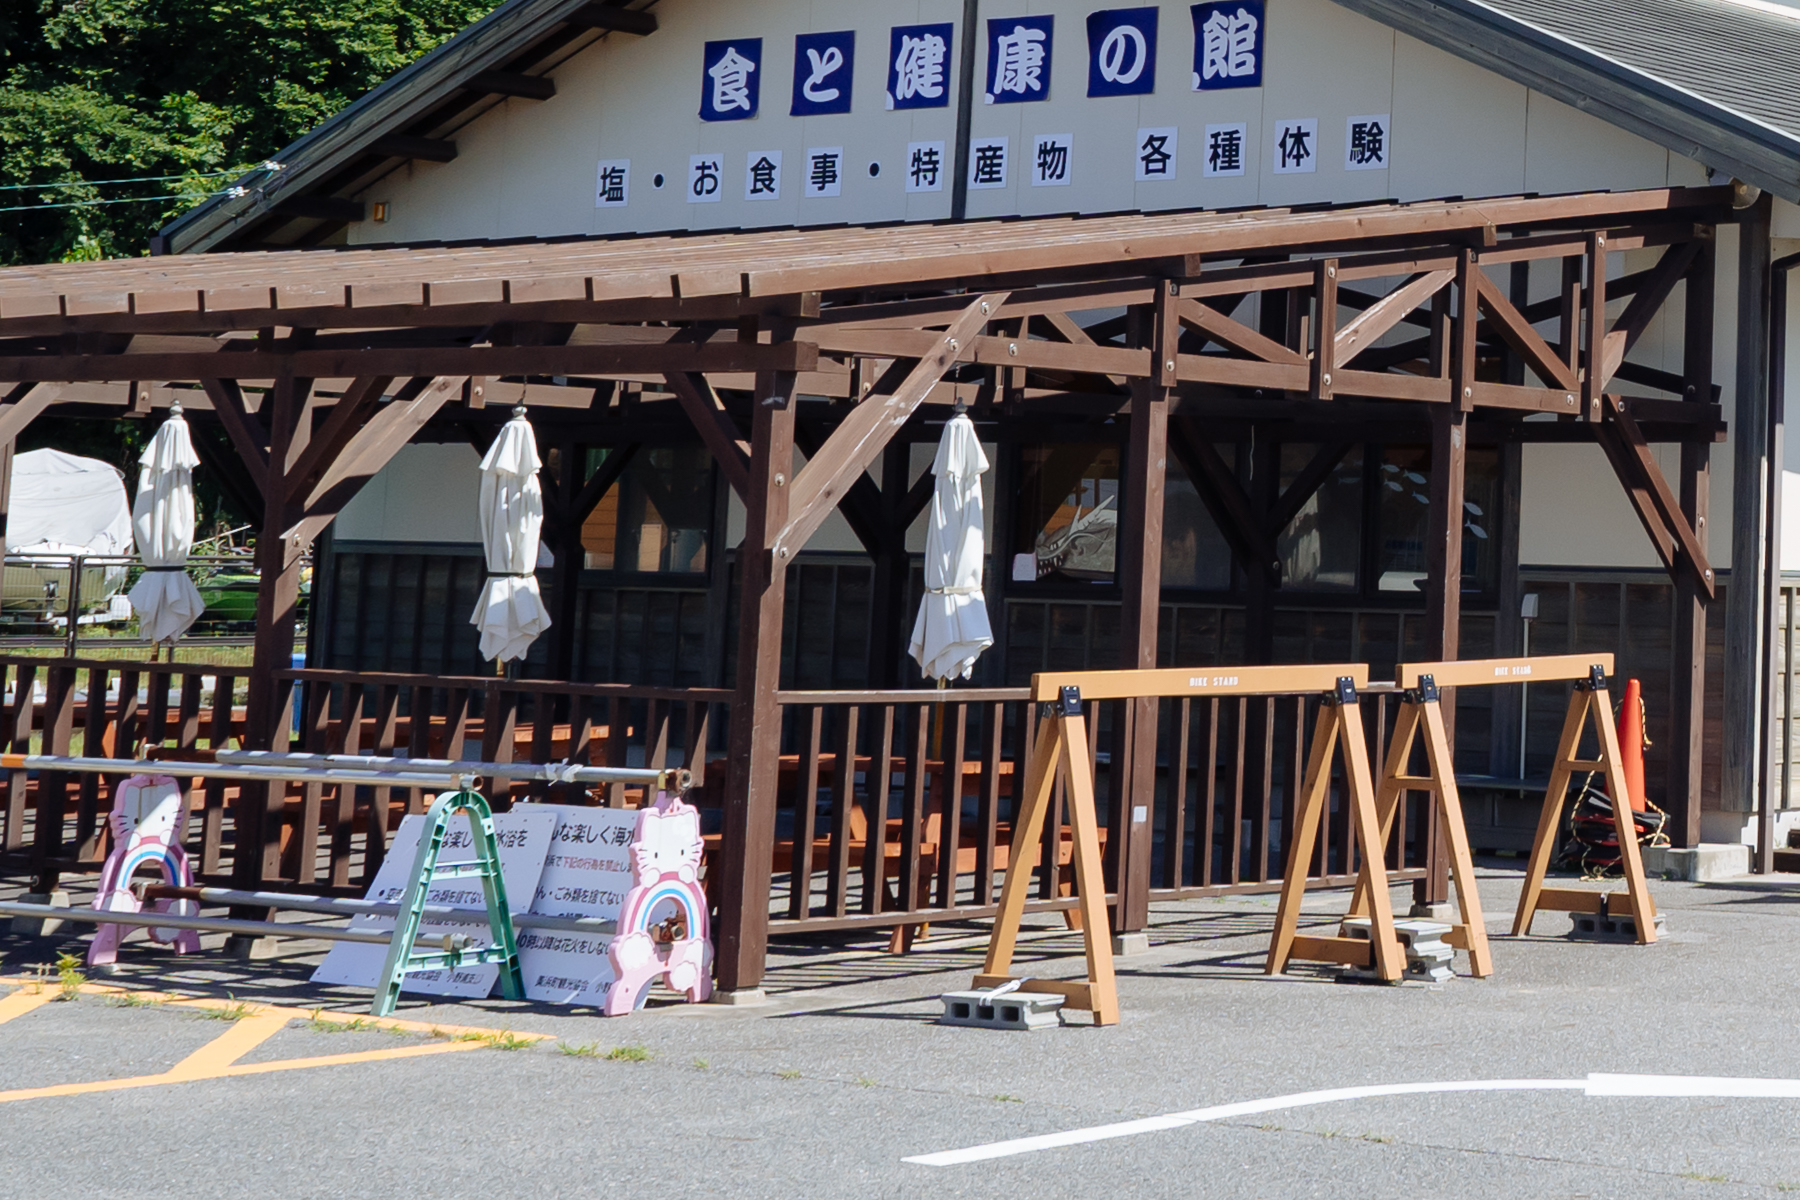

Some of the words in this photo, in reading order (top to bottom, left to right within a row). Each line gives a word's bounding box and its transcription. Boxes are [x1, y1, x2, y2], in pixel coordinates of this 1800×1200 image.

[705, 7, 1260, 114] 食と健康の館
[1138, 116, 1388, 177] 各種体験
[1189, 677, 1208, 687] BIKE
[1213, 676, 1239, 686] STAND
